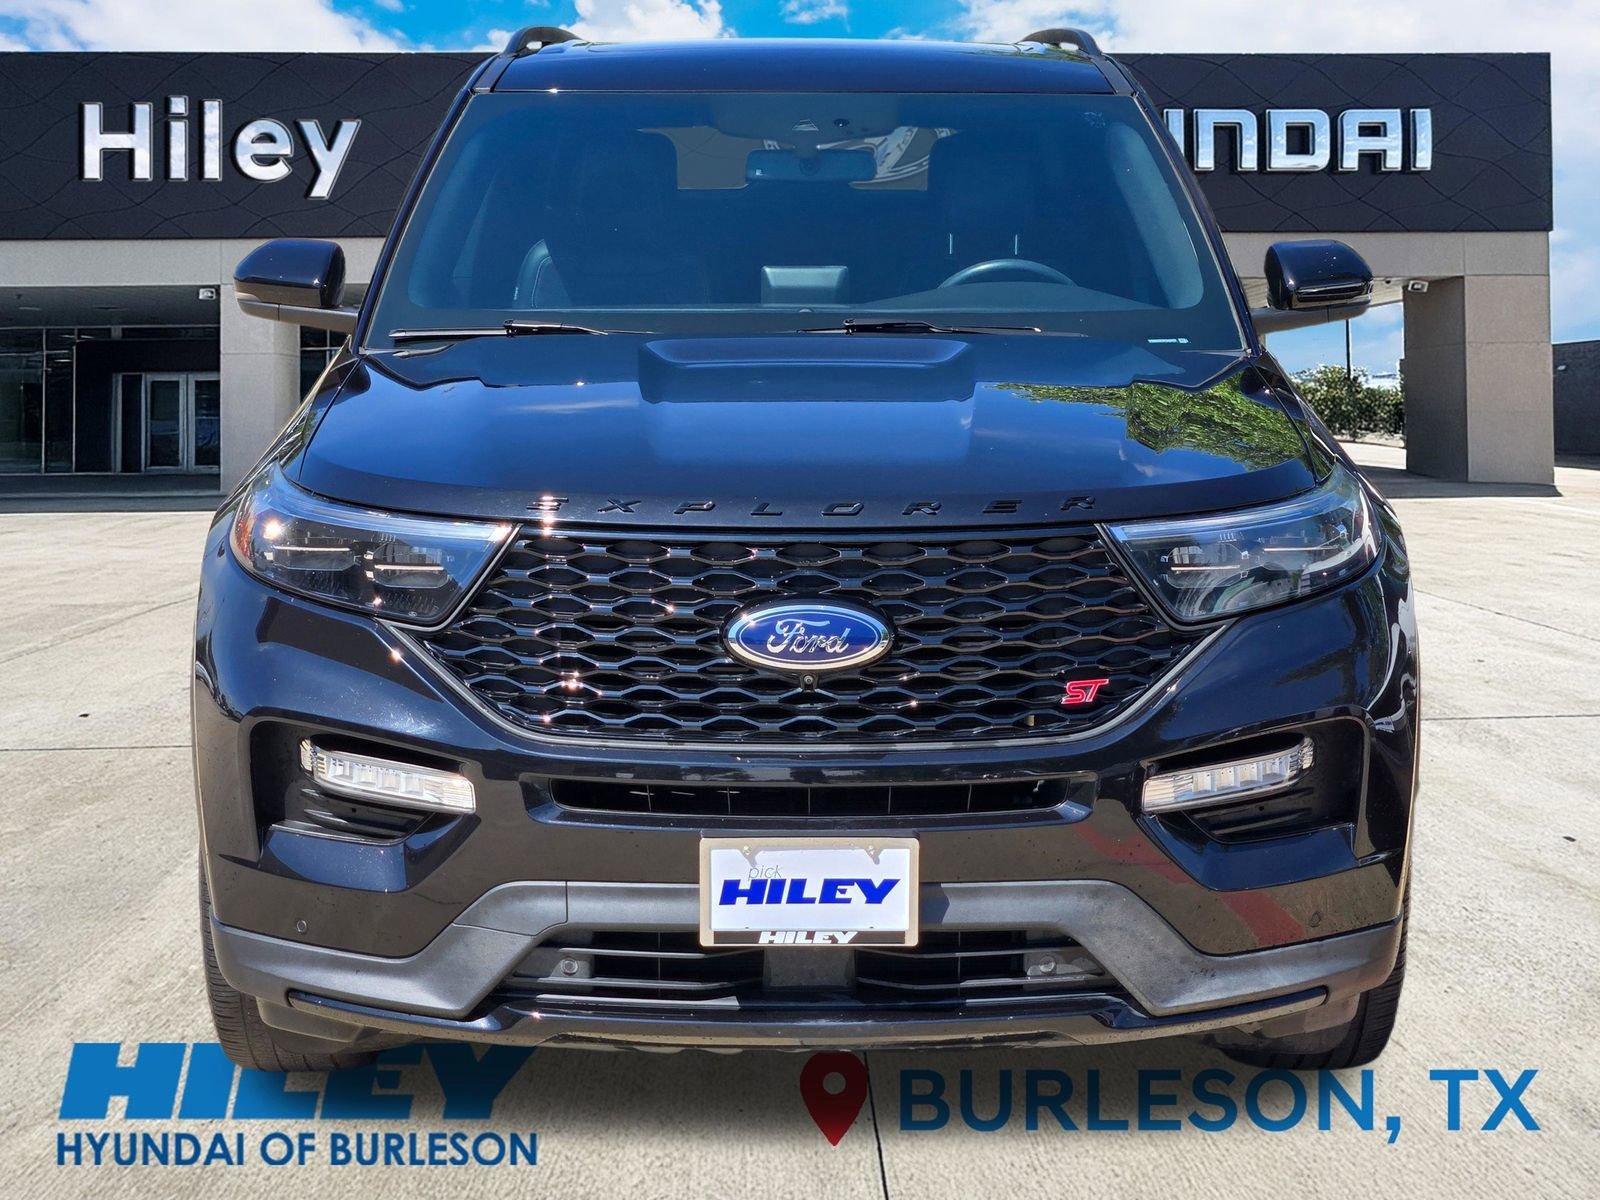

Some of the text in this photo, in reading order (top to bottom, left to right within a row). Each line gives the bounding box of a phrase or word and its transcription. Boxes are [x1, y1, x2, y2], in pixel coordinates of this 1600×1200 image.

[81, 95, 361, 199] Hiley
[1163, 108, 1433, 171] NDAI
[526, 496, 1096, 516] EXPLORER
[766, 618, 851, 654] Ford
[1061, 678, 1110, 704] ST
[748, 864, 784, 880] pick
[719, 879, 900, 905] HILEY
[759, 931, 858, 944] HILEY
